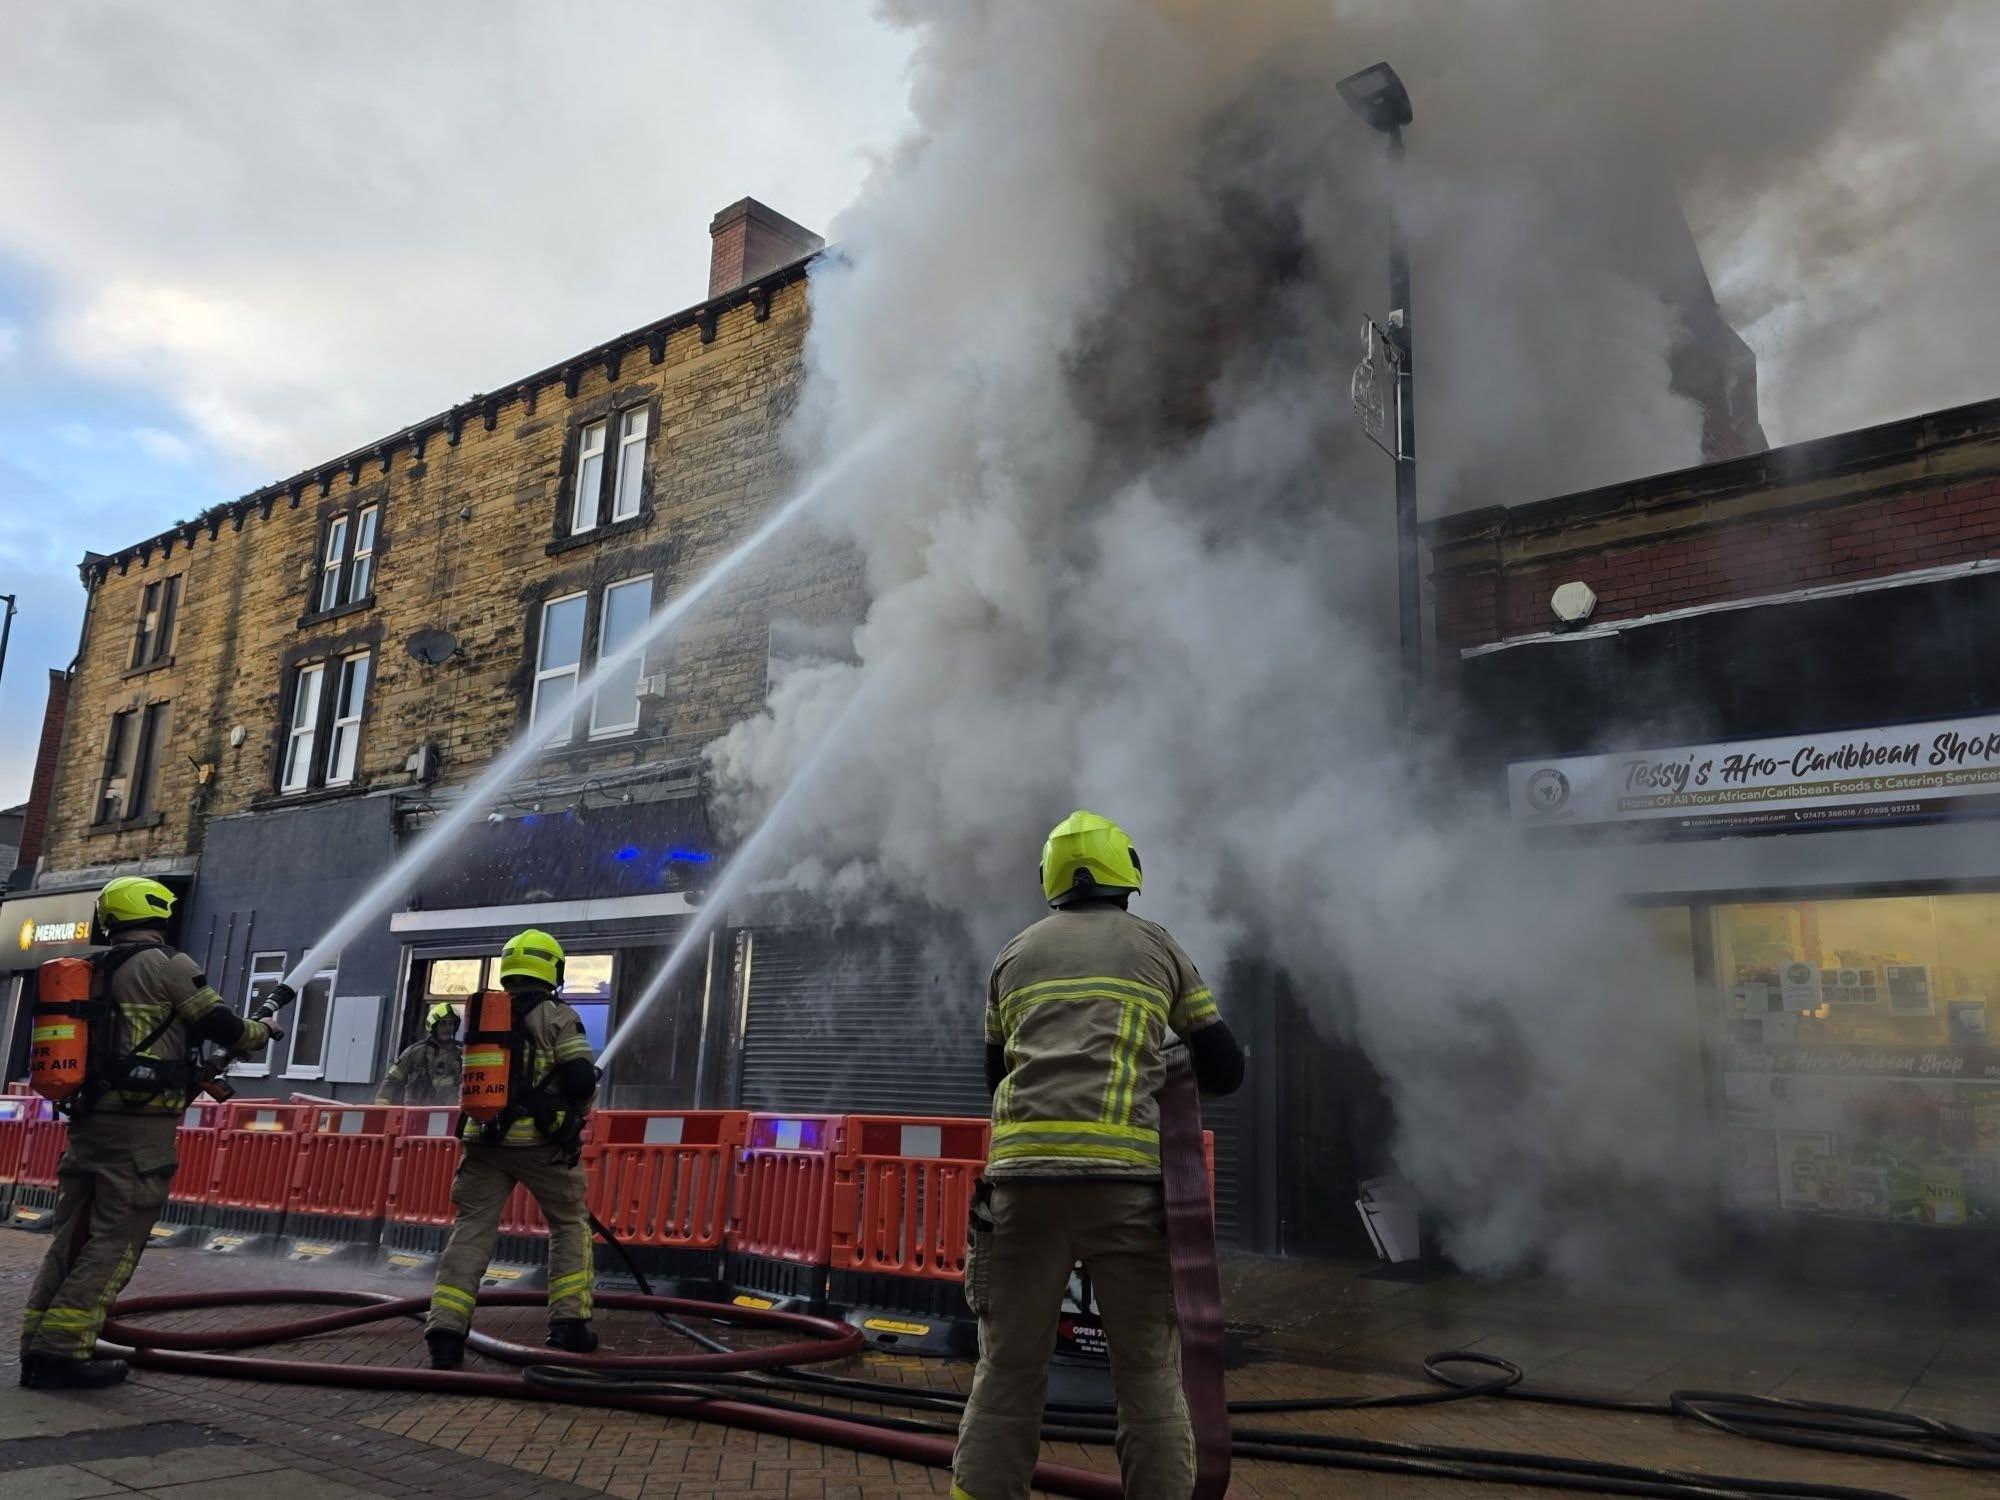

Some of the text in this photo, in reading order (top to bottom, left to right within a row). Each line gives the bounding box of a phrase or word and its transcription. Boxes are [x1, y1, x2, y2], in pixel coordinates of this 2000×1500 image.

[1623, 754, 1713, 793] Tessy's
[1720, 742, 1920, 784] Afro-Caribbean
[1622, 796, 1654, 809] Home
[1657, 795, 1671, 806] Of
[1674, 793, 1688, 805] All
[1691, 792, 1715, 804] Your
[1719, 784, 1830, 803] African/Caribbean
[1833, 782, 1871, 794] Foods
[1873, 779, 1883, 790] &
[1886, 775, 1943, 789] Catering
[35, 922, 75, 942] MERKUR
[50, 1058, 78, 1070] AIR
[485, 1083, 505, 1095] AIR
[1073, 1326, 1103, 1338] OPEN 7
